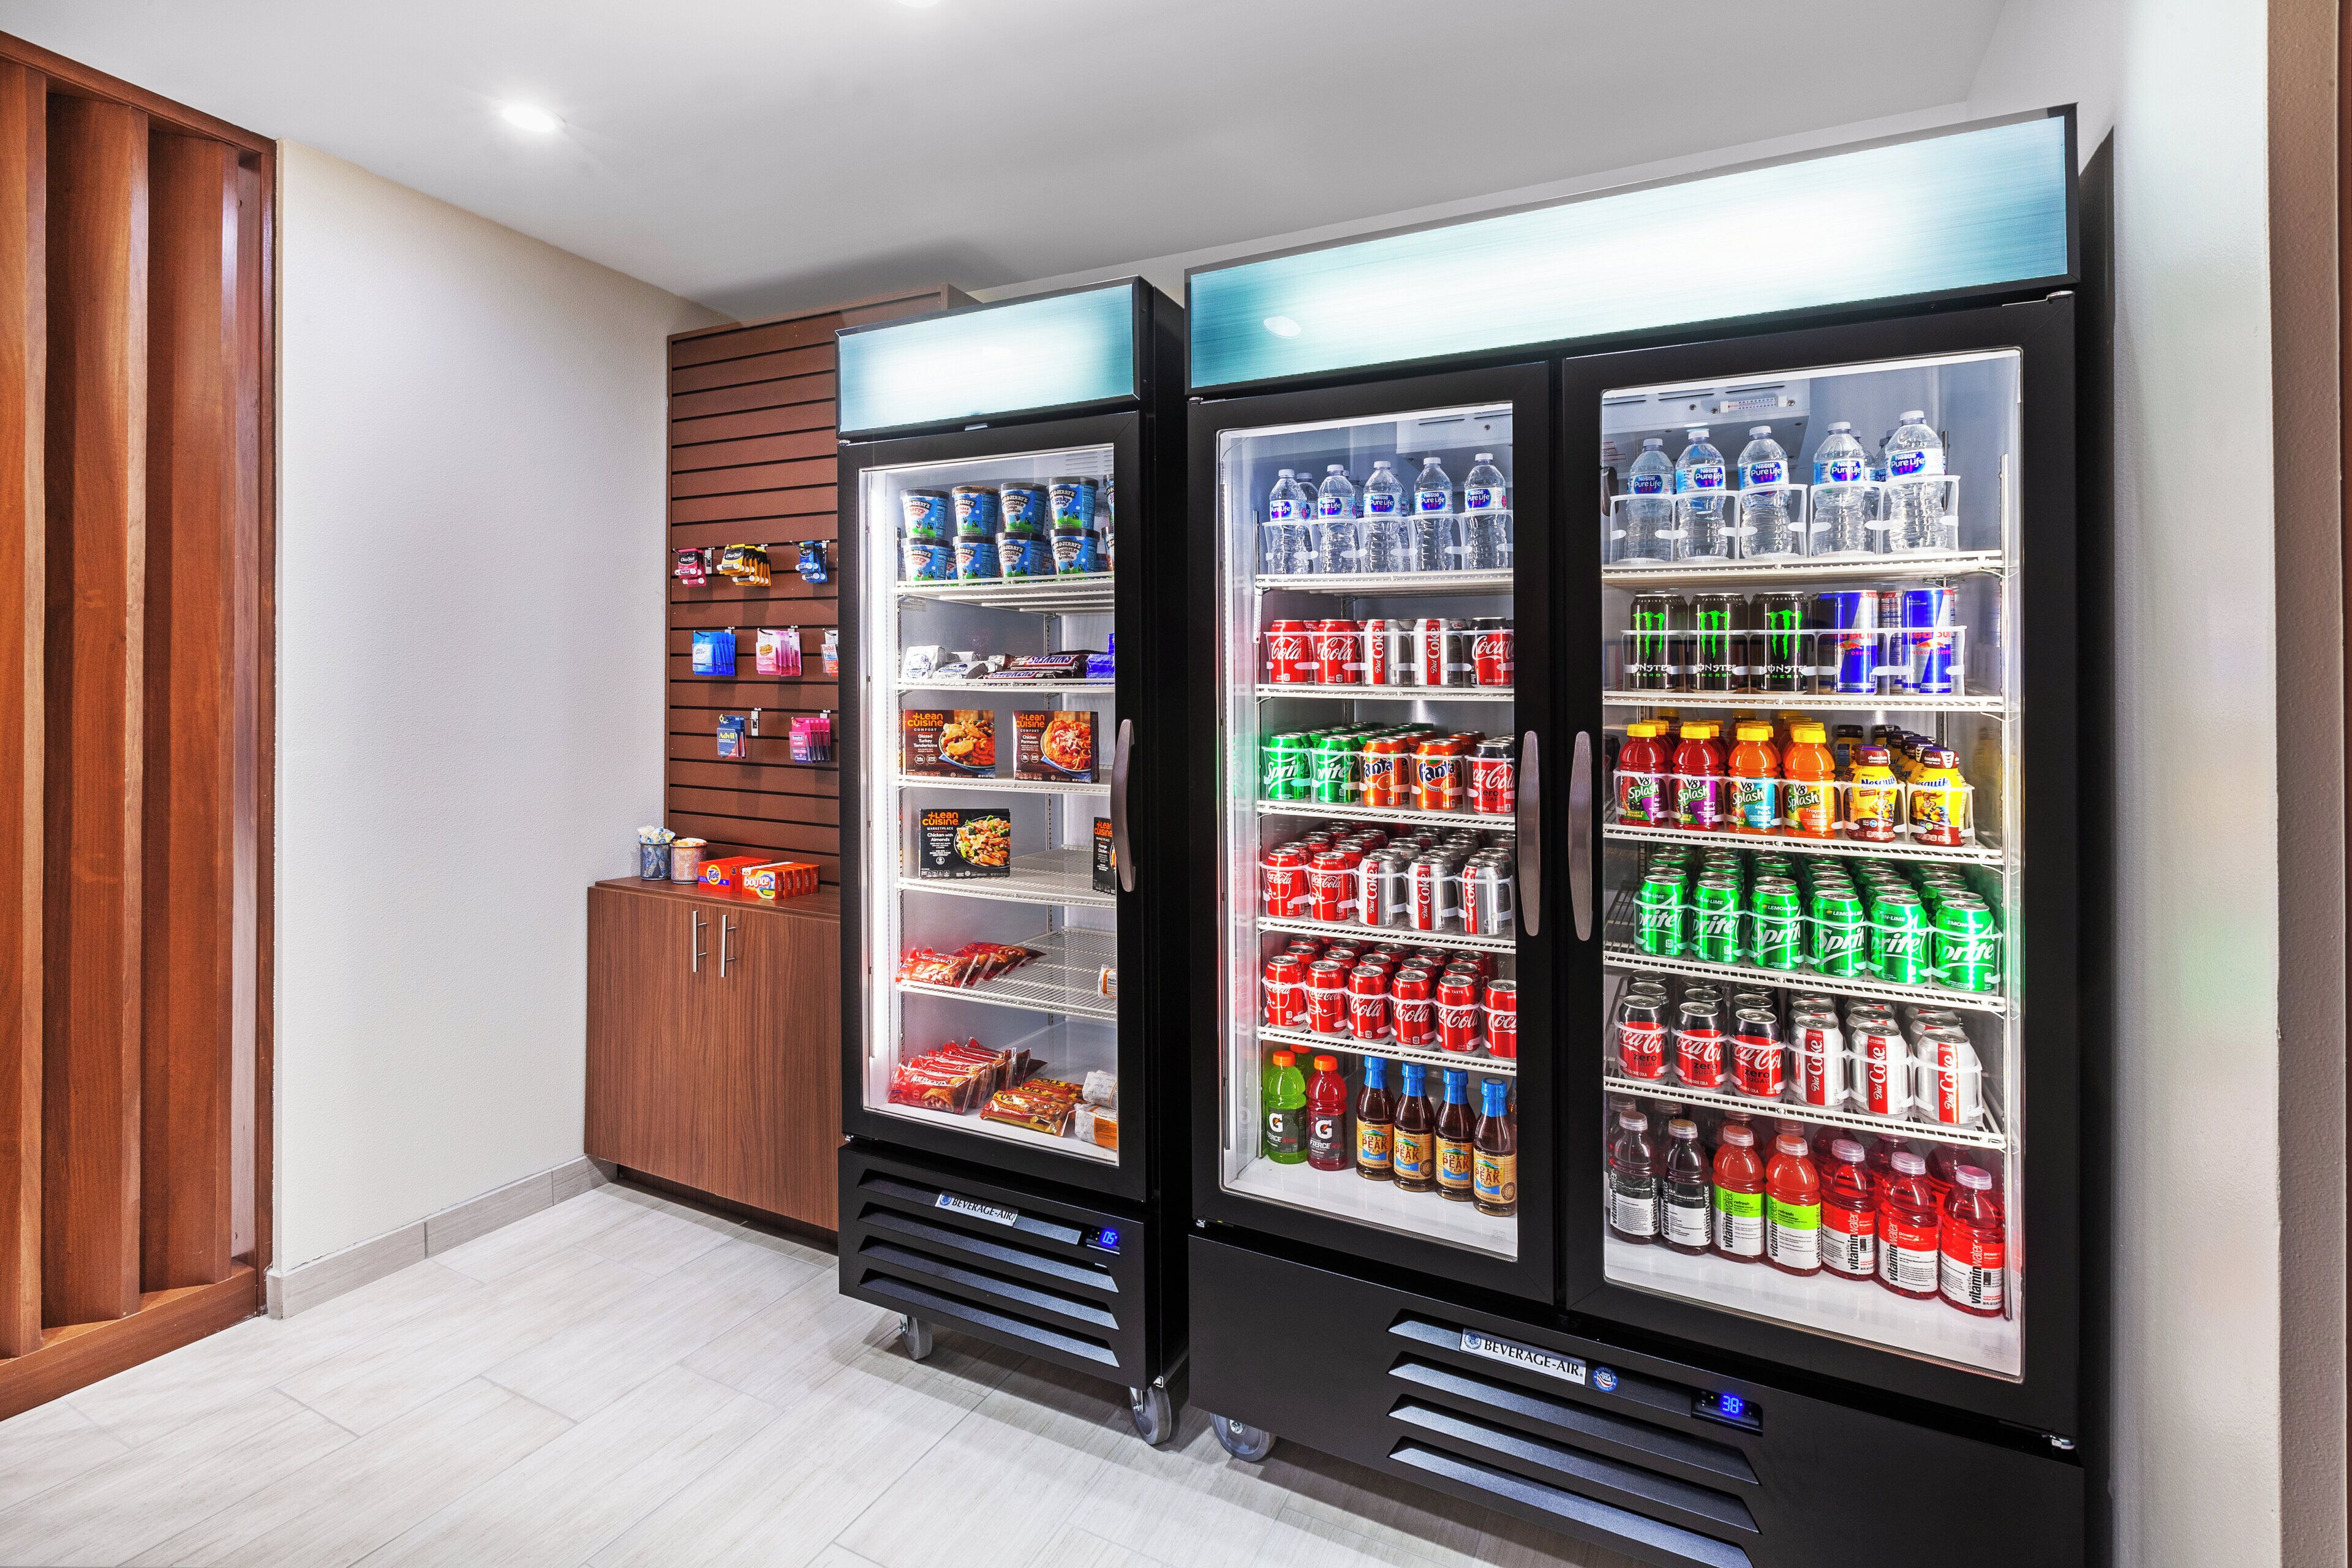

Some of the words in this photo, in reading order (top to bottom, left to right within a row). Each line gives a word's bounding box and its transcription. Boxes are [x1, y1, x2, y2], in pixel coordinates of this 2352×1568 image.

[1770, 467, 1782, 477] Life
[1910, 458, 1925, 467] Life
[1713, 472, 1723, 481] Life
[1384, 499, 1393, 508] Life
[1372, 628, 1384, 659] Coke
[1427, 627, 1440, 659] Coke
[1267, 761, 1305, 782] Sprite
[1363, 758, 1394, 778] anta
[1419, 760, 1455, 785] Fanta
[1638, 777, 1650, 786] V8
[1687, 779, 1698, 789] V8
[1740, 782, 1752, 791] V8
[1794, 784, 1806, 795] V8
[1628, 782, 1659, 801] Splash
[1678, 785, 1710, 804] Splash
[1732, 789, 1765, 808] Splash
[1788, 791, 1820, 810] Splash
[708, 870, 720, 880] Tide
[744, 876, 771, 888] bounce
[1366, 869, 1378, 900] Coke
[1418, 873, 1430, 905] Coke
[1639, 909, 1682, 929] prite
[1693, 914, 1738, 934] prite
[1751, 920, 1801, 946] Sprit
[1819, 927, 1864, 953] Sprit
[1872, 933, 1921, 954] prite
[1693, 1061, 1717, 1070] zero
[1807, 1039, 1823, 1076] Coke
[1869, 1047, 1886, 1084] Coke
[1744, 1068, 1770, 1078] zero
[1939, 1055, 1959, 1093] Coke
[1811, 1076, 1820, 1091] Diet
[1873, 1084, 1883, 1100] Diet
[1943, 1091, 1954, 1110] Diet
[1268, 1112, 1284, 1133] G
[1315, 1120, 1332, 1139] G
[1310, 1139, 1332, 1149] FIERCE
[1362, 1139, 1387, 1150] PEAK
[1395, 1141, 1419, 1152] GOLD
[1395, 1146, 1419, 1162] PEAK
[1442, 1157, 1470, 1169] PEAK
[1475, 1163, 1500, 1175] GOLD
[1475, 1168, 1501, 1184] PEAK
[951, 1197, 1012, 1221] BEVERAGE-AIR
[1723, 1191, 1733, 1248] vitaminwater
[1769, 1199, 1778, 1257] vitaminwater
[1847, 1212, 1859, 1270] vitaminwater
[1887, 1221, 1898, 1281] vitaminwater
[1969, 1242, 1983, 1304] vitaminwater
[1483, 1339, 1580, 1376] BEVERAGE-AIR
